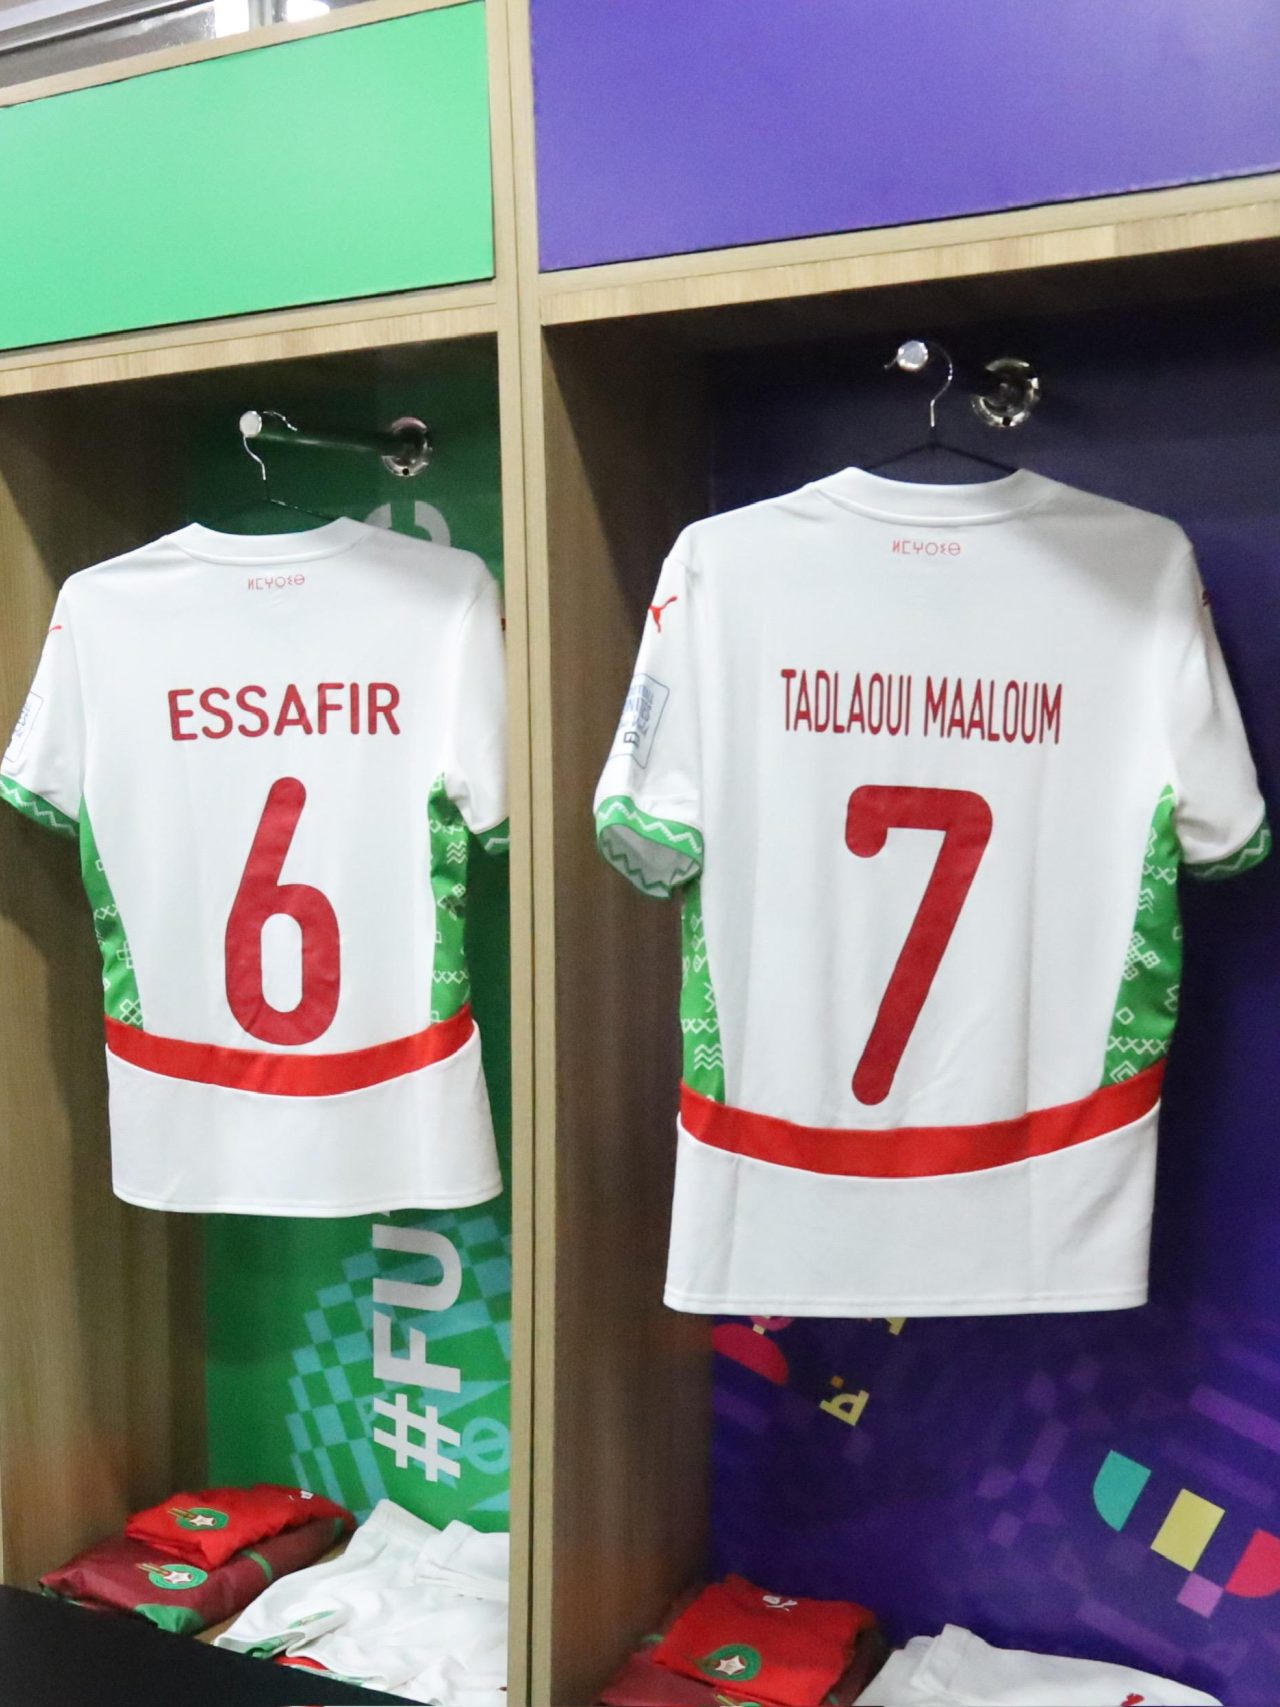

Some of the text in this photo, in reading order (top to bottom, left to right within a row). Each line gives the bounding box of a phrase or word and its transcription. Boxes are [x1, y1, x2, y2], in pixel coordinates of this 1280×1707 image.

[168, 682, 401, 741] ESSAFIR
[780, 669, 1064, 745] TADLAOUI MAALOUM
[225, 776, 342, 1046] 6
[845, 784, 994, 1106] 7
[372, 1210, 463, 1483] #FU
